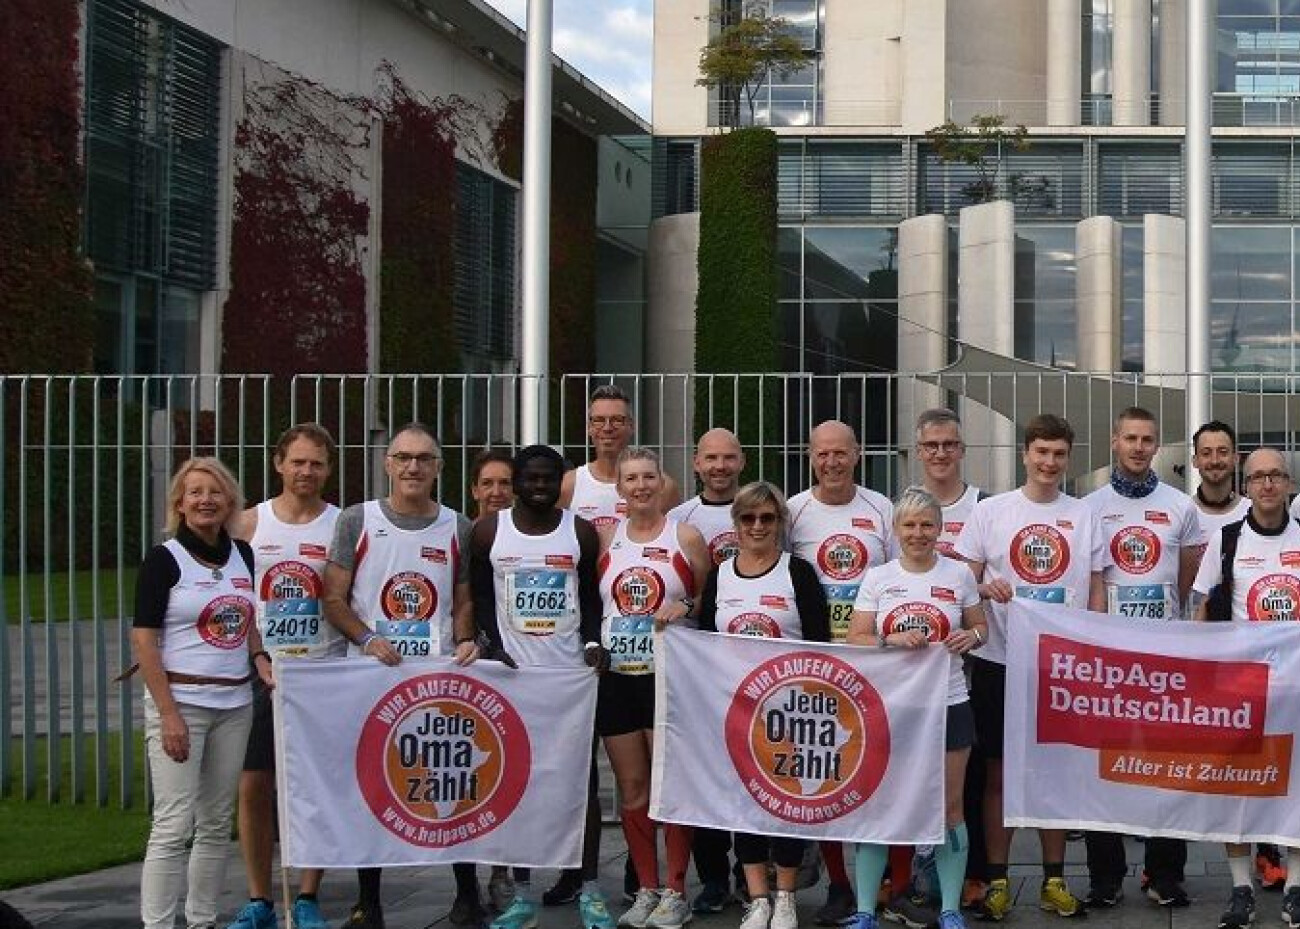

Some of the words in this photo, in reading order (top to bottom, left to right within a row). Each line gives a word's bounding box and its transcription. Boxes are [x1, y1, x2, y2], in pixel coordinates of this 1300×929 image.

[273, 584, 304, 598] Oma
[516, 591, 567, 610] 61662
[1262, 597, 1292, 611] Oma
[265, 618, 319, 637] 24019
[390, 639, 430, 656] 039
[743, 668, 775, 699] WIR
[773, 658, 834, 680] LAUFEN
[1050, 652, 1186, 693] HelpAge
[377, 695, 408, 725] WIR
[406, 679, 473, 701] LAUFEN
[783, 689, 838, 716] Jede
[1049, 686, 1252, 730] Deutschland
[416, 712, 476, 737] Jede
[766, 709, 836, 747] Oma
[400, 734, 473, 768] Oma
[773, 747, 842, 781] zählt
[1111, 755, 1163, 777] Alter
[1167, 760, 1194, 780] ist
[1196, 762, 1279, 786] Zukunft
[407, 772, 479, 802] zählt
[382, 807, 497, 845] www.helpage.de
